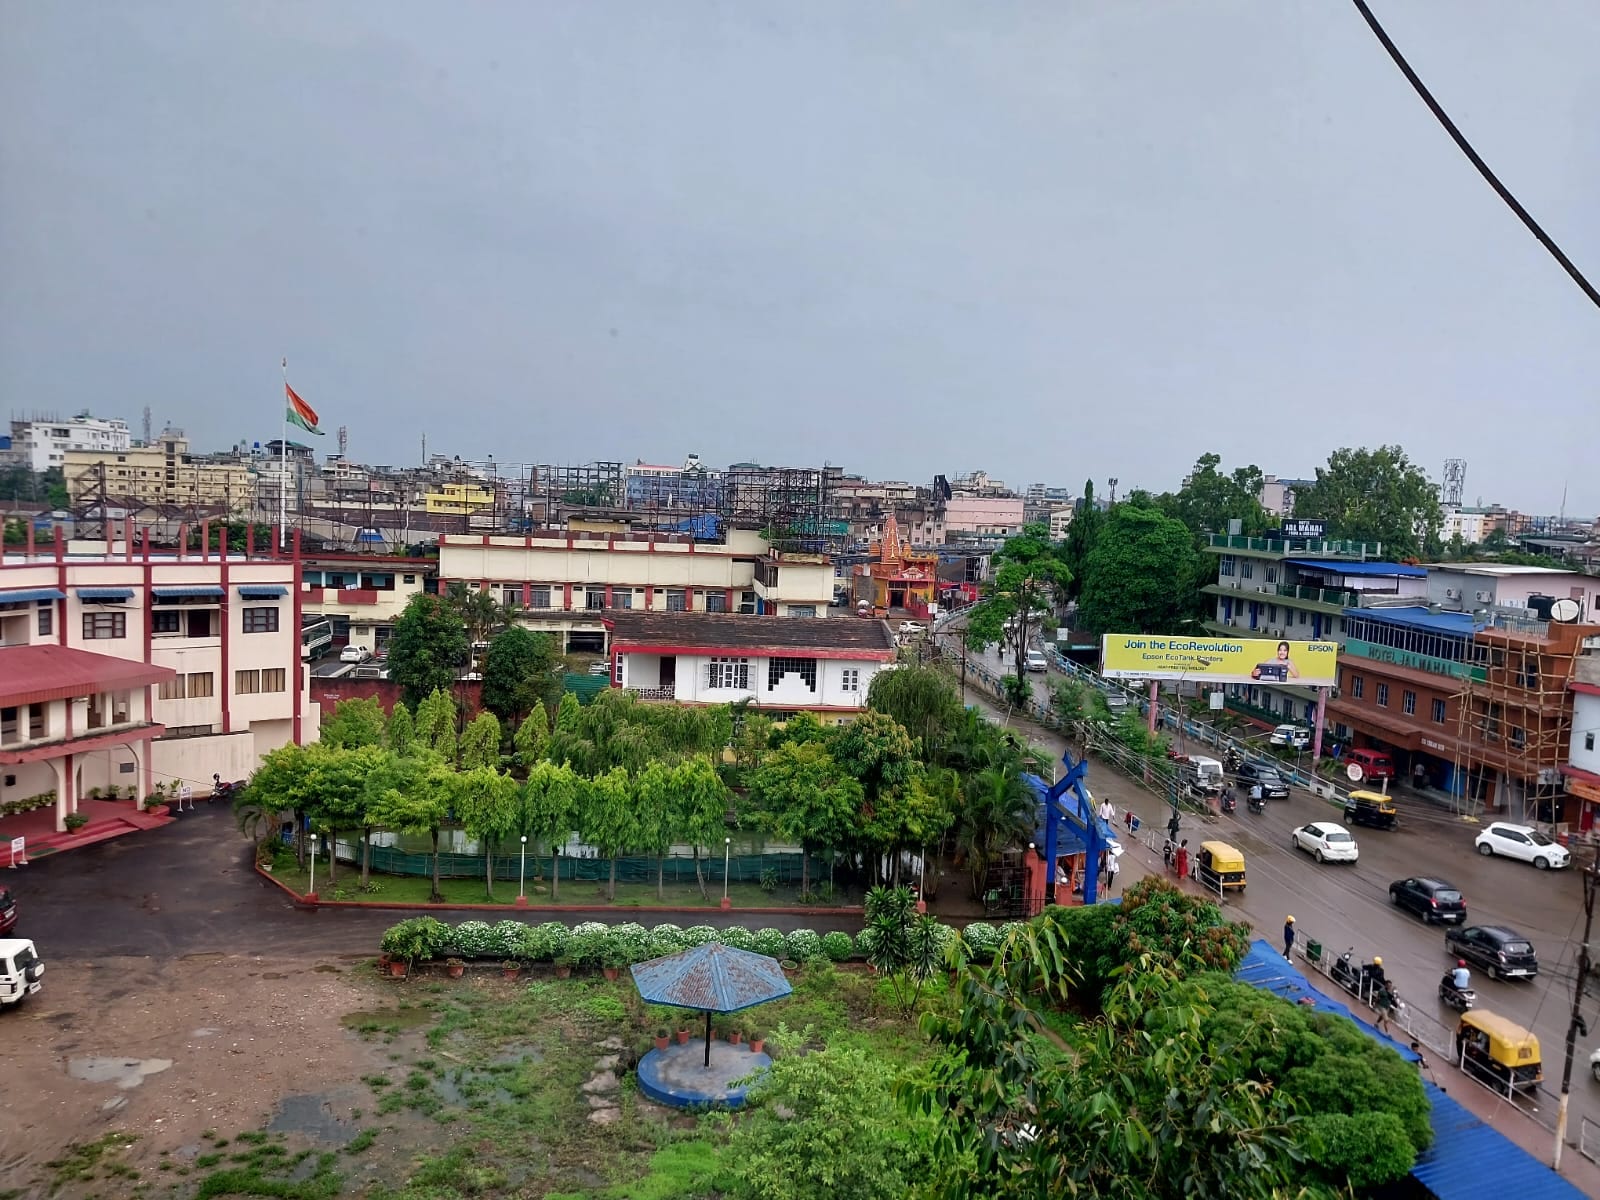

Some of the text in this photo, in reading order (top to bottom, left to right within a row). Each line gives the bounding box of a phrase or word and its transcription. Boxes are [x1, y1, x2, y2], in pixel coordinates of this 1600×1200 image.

[1124, 639, 1243, 653] Join the EcoRevolution
[1307, 644, 1334, 652] EPSON
[1142, 652, 1164, 661] Epson
[1165, 653, 1194, 661] EcoTank
